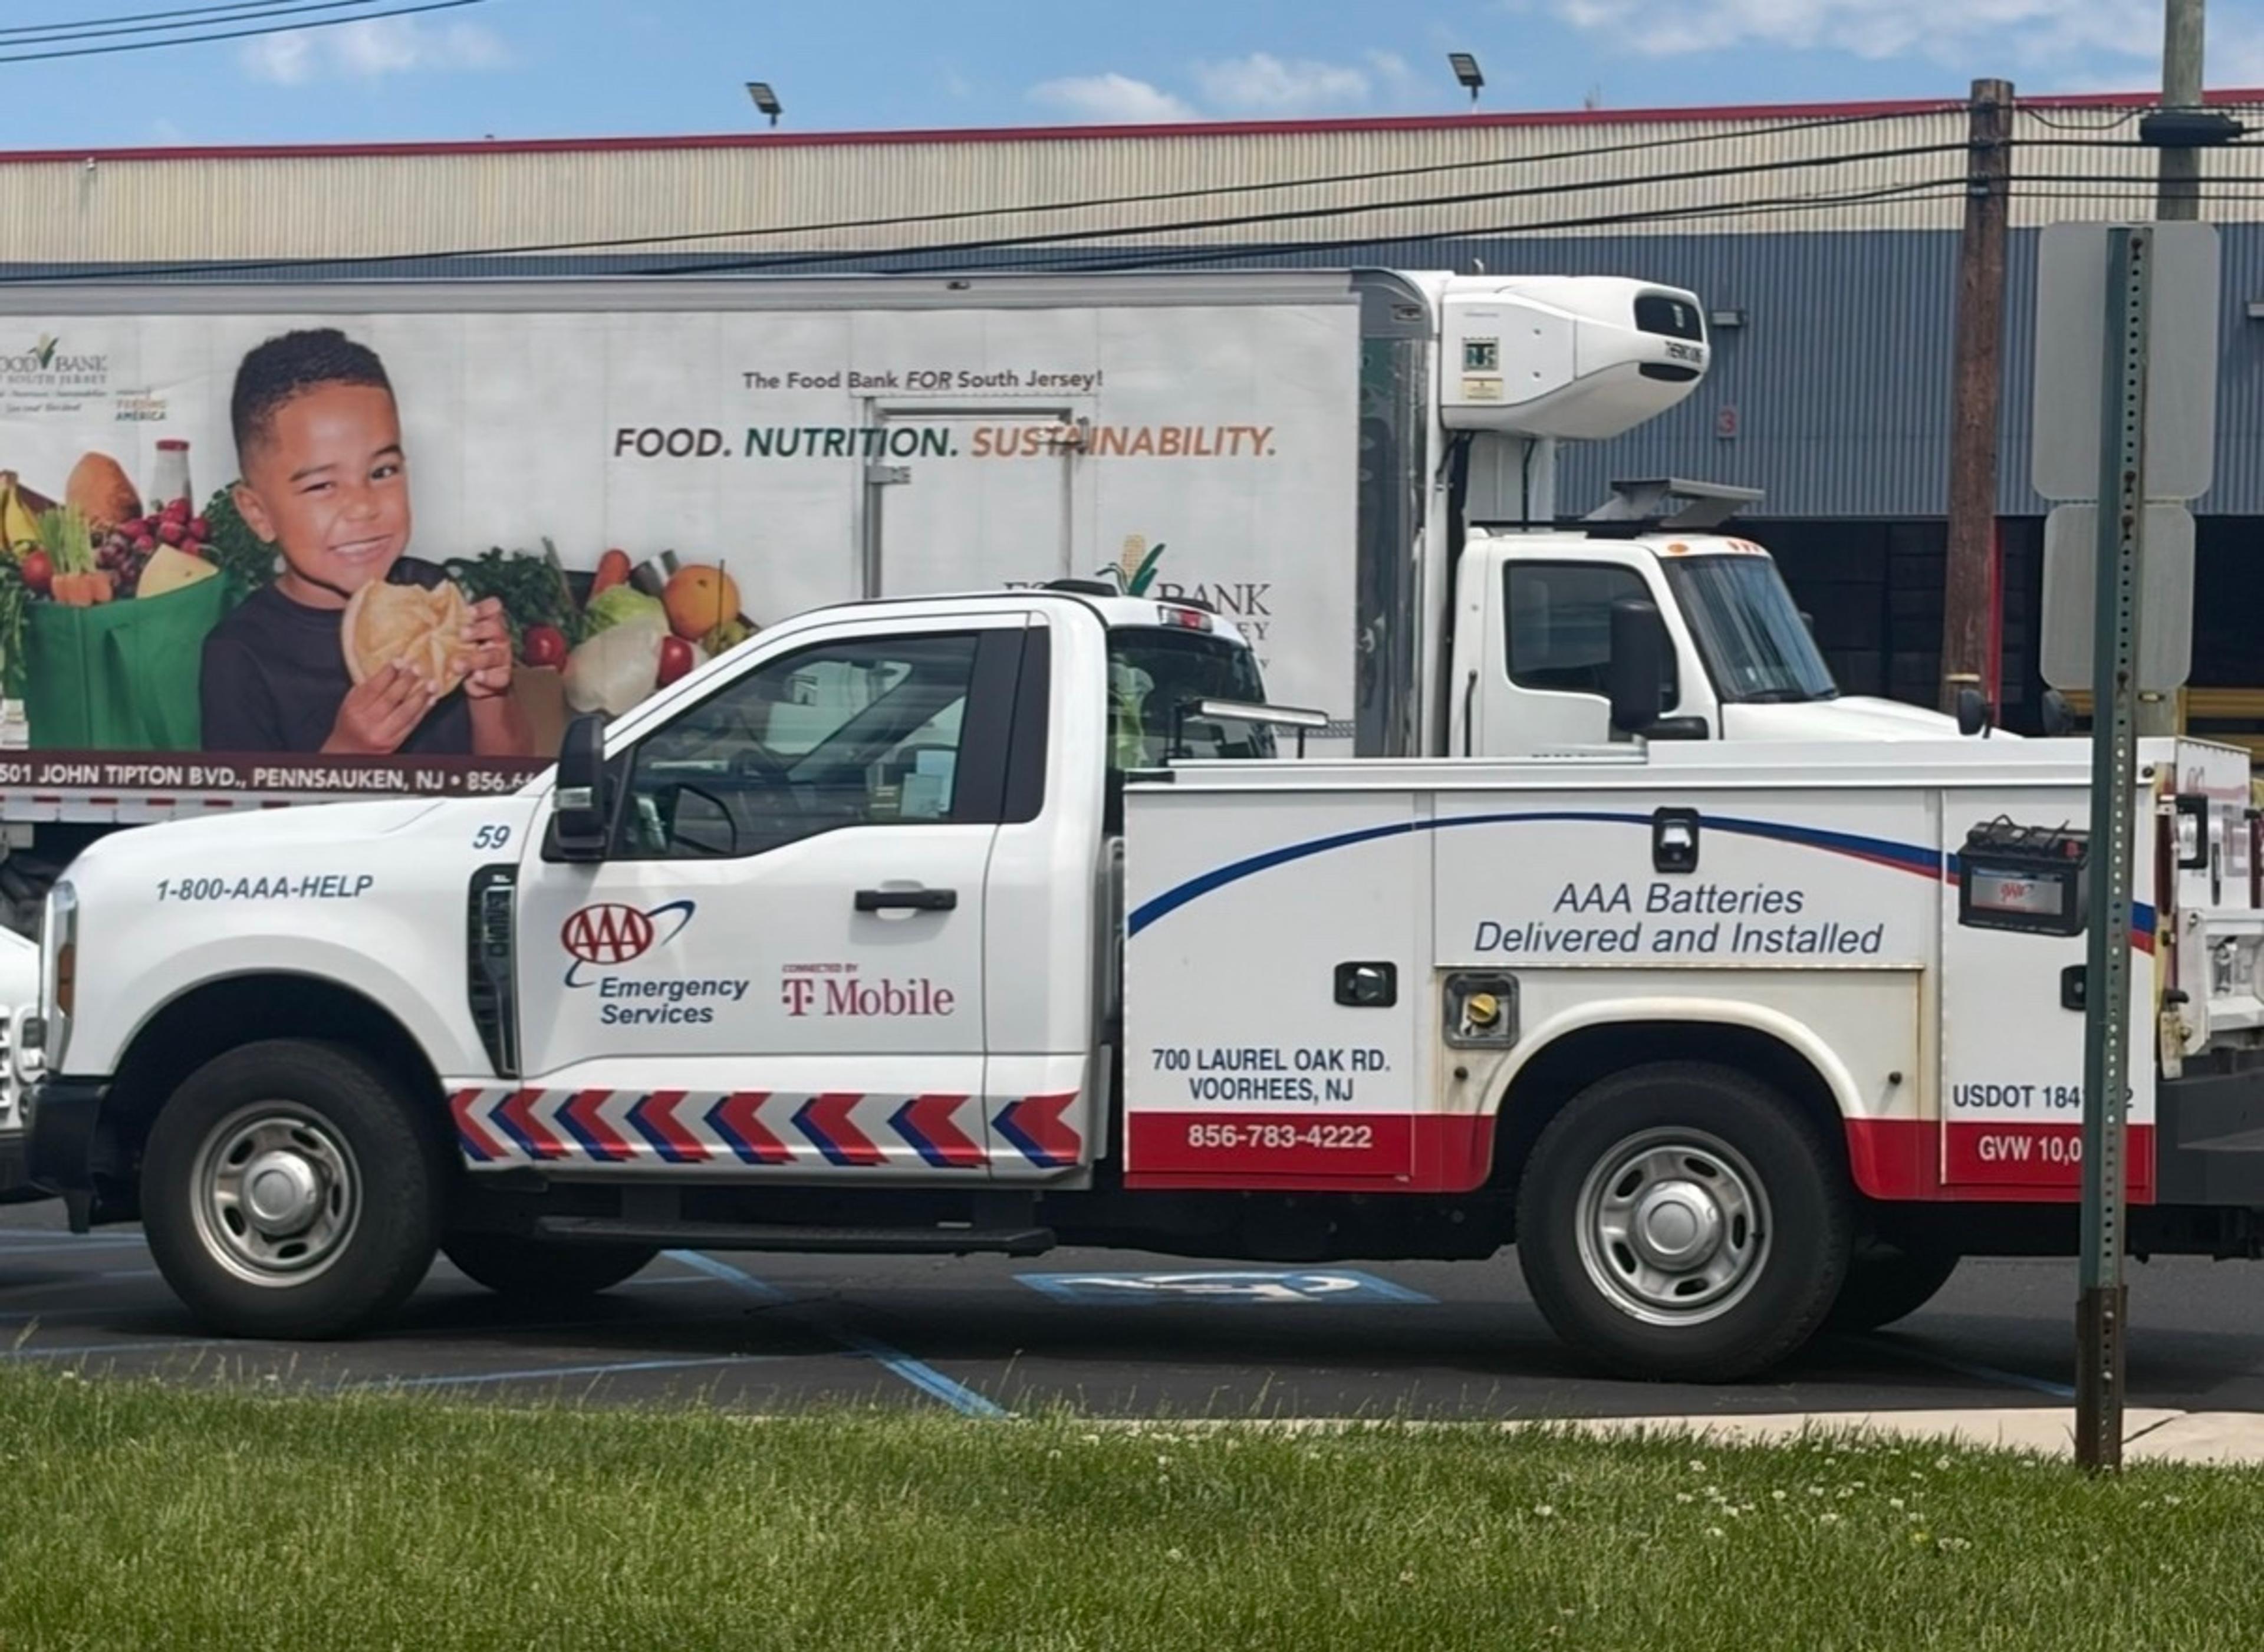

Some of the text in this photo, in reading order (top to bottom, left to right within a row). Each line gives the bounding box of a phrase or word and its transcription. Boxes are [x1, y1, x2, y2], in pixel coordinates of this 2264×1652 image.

[55, 356, 107, 372] BANK
[743, 370, 1103, 391] The Food Bank FOR South Jersey!
[614, 426, 1276, 457] FOOD. NUTRITION. SUSTAINABILITY.
[38, 764, 99, 784] JOHN
[106, 765, 185, 785] TIPTON
[189, 766, 246, 789] BVD.,
[254, 768, 409, 791] PENNSAUKEN,
[416, 770, 444, 789] NJ
[473, 826, 511, 850] 59
[157, 875, 373, 901] 1-800-AAA-HELP
[1553, 884, 1804, 914] AAA Batteries
[564, 904, 650, 963] AAA
[1475, 922, 1884, 954] Delivered and Installed
[782, 963, 858, 973] CONNECTED BY
[600, 976, 750, 1001] Emergency
[824, 978, 955, 1016] Mobile
[601, 1004, 714, 1024] Services
[1152, 1049, 1391, 1071] 700 LAUREL OAK RD.
[1189, 1078, 1354, 1105] VOORHEES, NJ
[1953, 1085, 2035, 1108] USDOT
[1187, 1124, 1373, 1148] 856-783-4222
[1978, 1136, 2032, 1161] GVW
